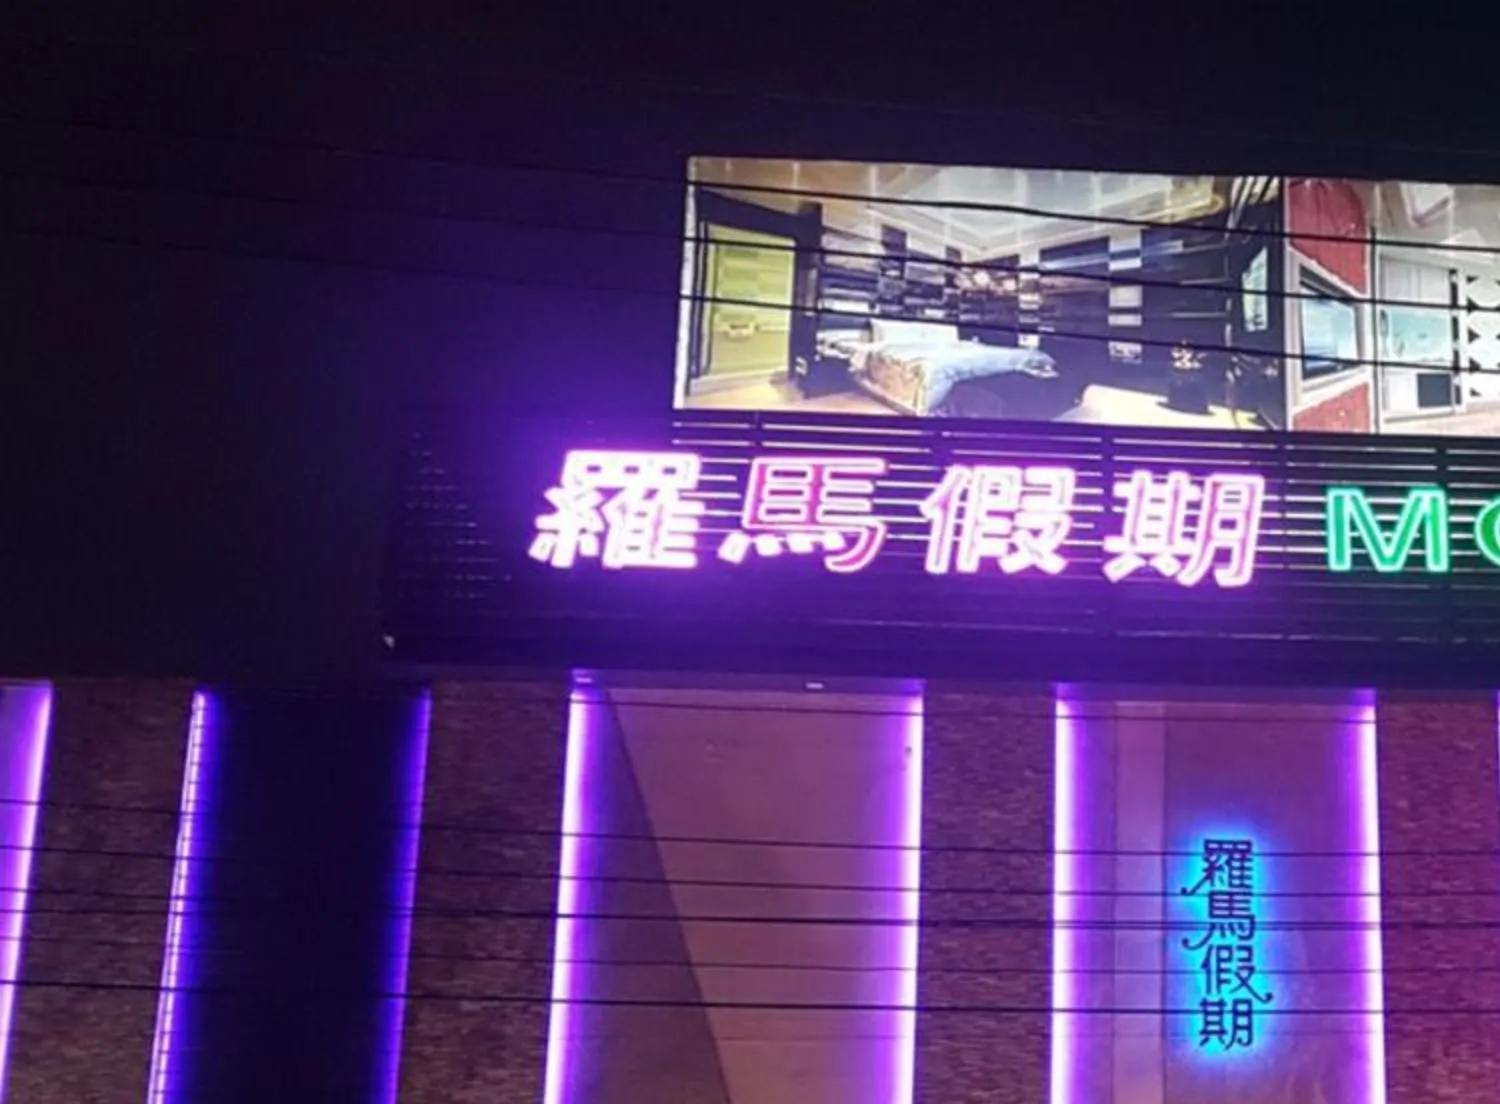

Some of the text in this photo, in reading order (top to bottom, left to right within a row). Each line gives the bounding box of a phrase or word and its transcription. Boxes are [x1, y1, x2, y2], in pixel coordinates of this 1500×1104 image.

[528, 449, 1266, 588] 羅馬假期
[1180, 838, 1274, 1051] 羅馬假期
